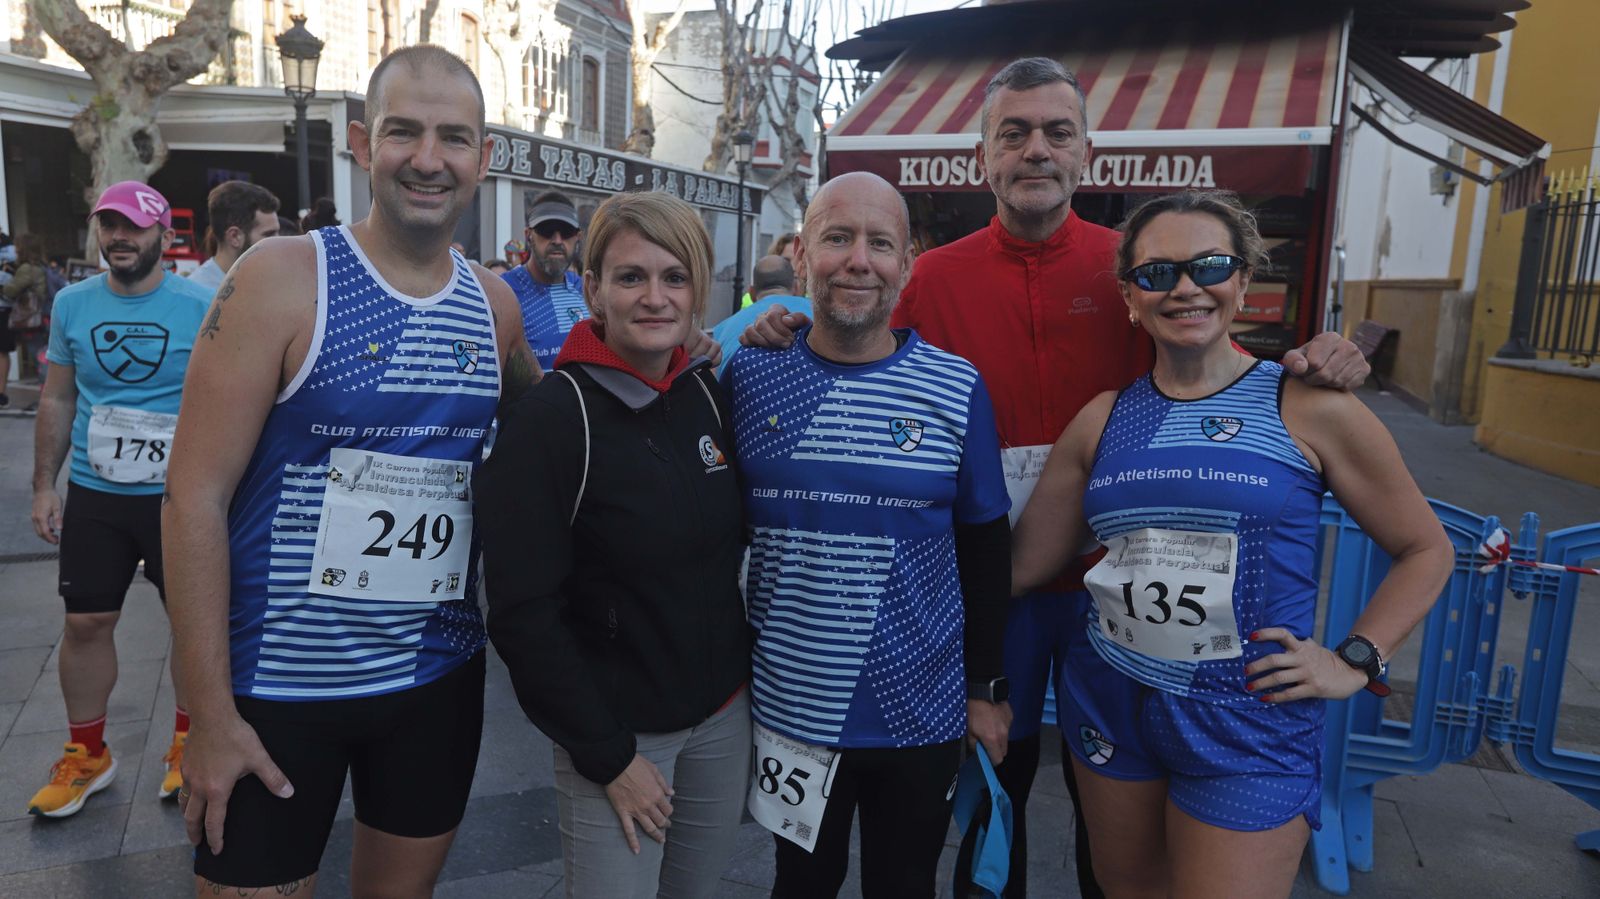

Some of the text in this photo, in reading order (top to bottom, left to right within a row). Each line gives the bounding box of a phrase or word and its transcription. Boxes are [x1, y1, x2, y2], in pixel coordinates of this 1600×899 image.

[489, 133, 532, 176] DE
[540, 144, 627, 192] TAPAS
[651, 168, 680, 197] LA
[684, 175, 753, 212] PARADA
[310, 423, 356, 437] CLUB
[362, 425, 449, 438] ATLETISMO
[112, 436, 166, 463] 178
[373, 460, 383, 469] IX
[386, 462, 420, 473] Carrera
[370, 470, 446, 486] Inmaculada
[1089, 467, 1269, 491] Club Atletismo Linense
[753, 488, 779, 498] CLUB
[783, 489, 871, 505] ATLETISMO
[361, 509, 455, 561] 249
[1160, 537, 1196, 546] Popular
[1118, 579, 1207, 627] 135
